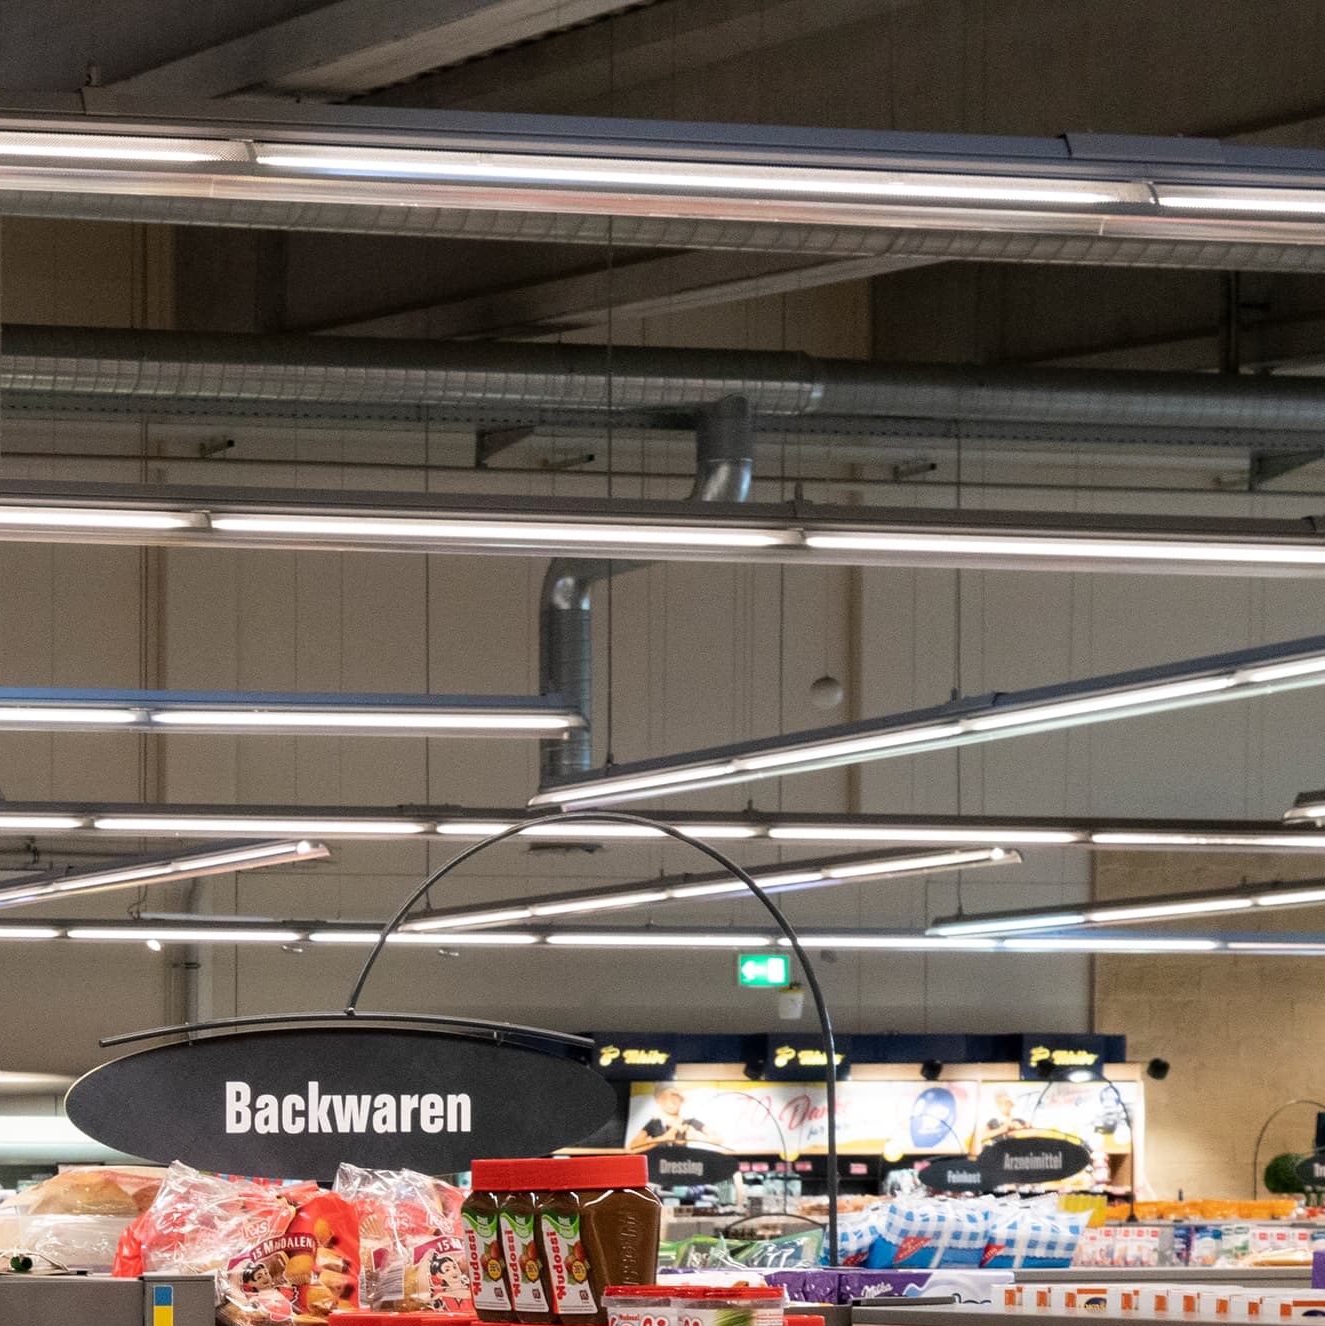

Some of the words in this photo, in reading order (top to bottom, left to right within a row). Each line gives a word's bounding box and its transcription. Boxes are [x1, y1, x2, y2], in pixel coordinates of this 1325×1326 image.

[225, 1081, 472, 1134] Backwaren
[659, 1158, 704, 1176] Dressing
[1003, 1151, 1063, 1171] Arzneimittel
[465, 1229, 483, 1297] Nudossi
[504, 1229, 522, 1298] Nudossi
[546, 1231, 567, 1300] Nudossi
[861, 1281, 894, 1299] Milka
